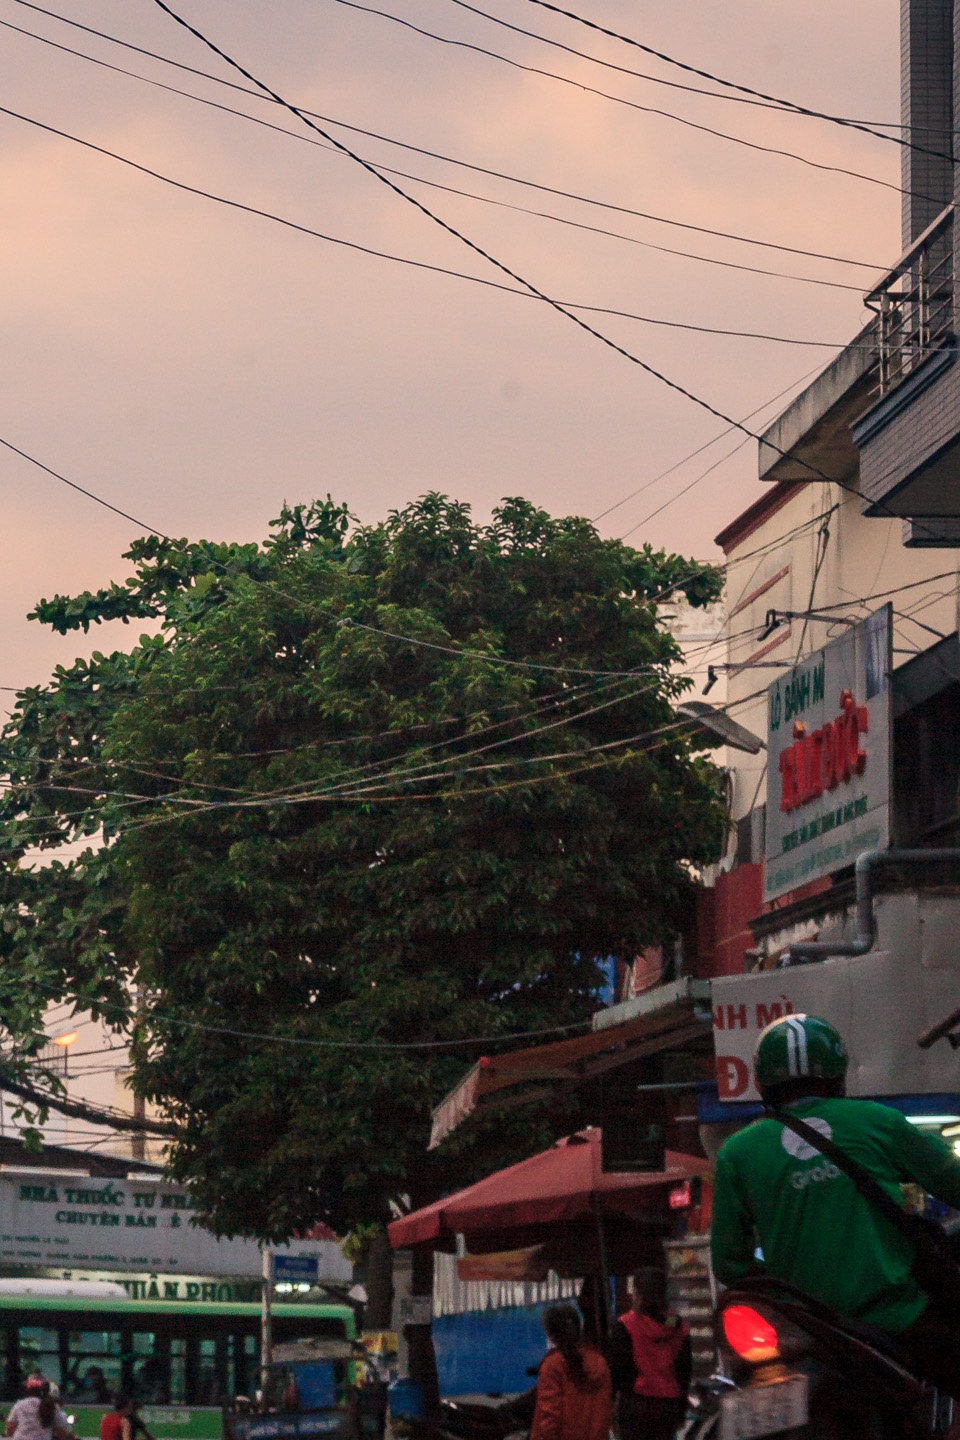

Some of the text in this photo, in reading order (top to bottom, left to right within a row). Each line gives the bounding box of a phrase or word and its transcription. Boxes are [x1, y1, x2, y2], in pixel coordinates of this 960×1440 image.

[790, 1160, 842, 1190] Grab
[63, 1180, 126, 1206] THUỐC
[55, 1210, 120, 1226] CHUYÊN
